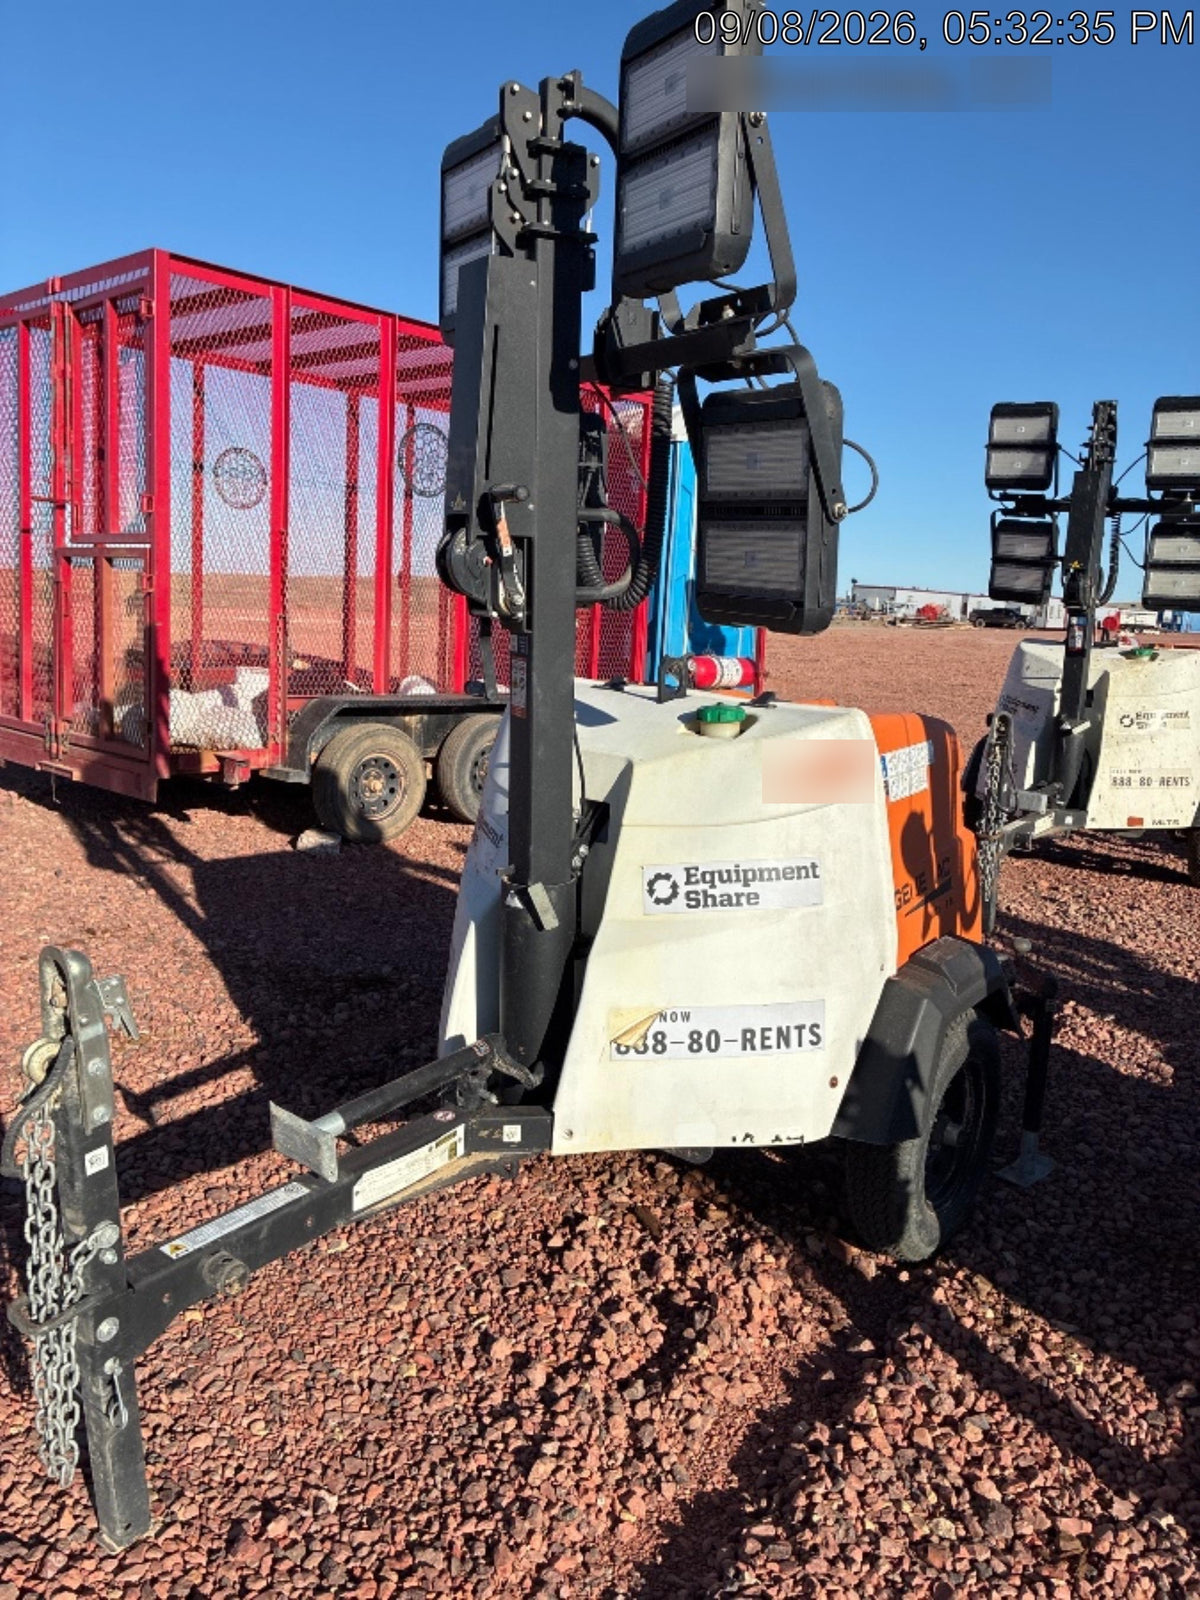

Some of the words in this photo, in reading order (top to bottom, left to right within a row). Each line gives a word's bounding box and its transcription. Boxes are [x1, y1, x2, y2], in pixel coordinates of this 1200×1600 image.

[684, 862, 820, 889] Equipment
[684, 890, 760, 909] Share
[659, 1011, 691, 1023] NOW
